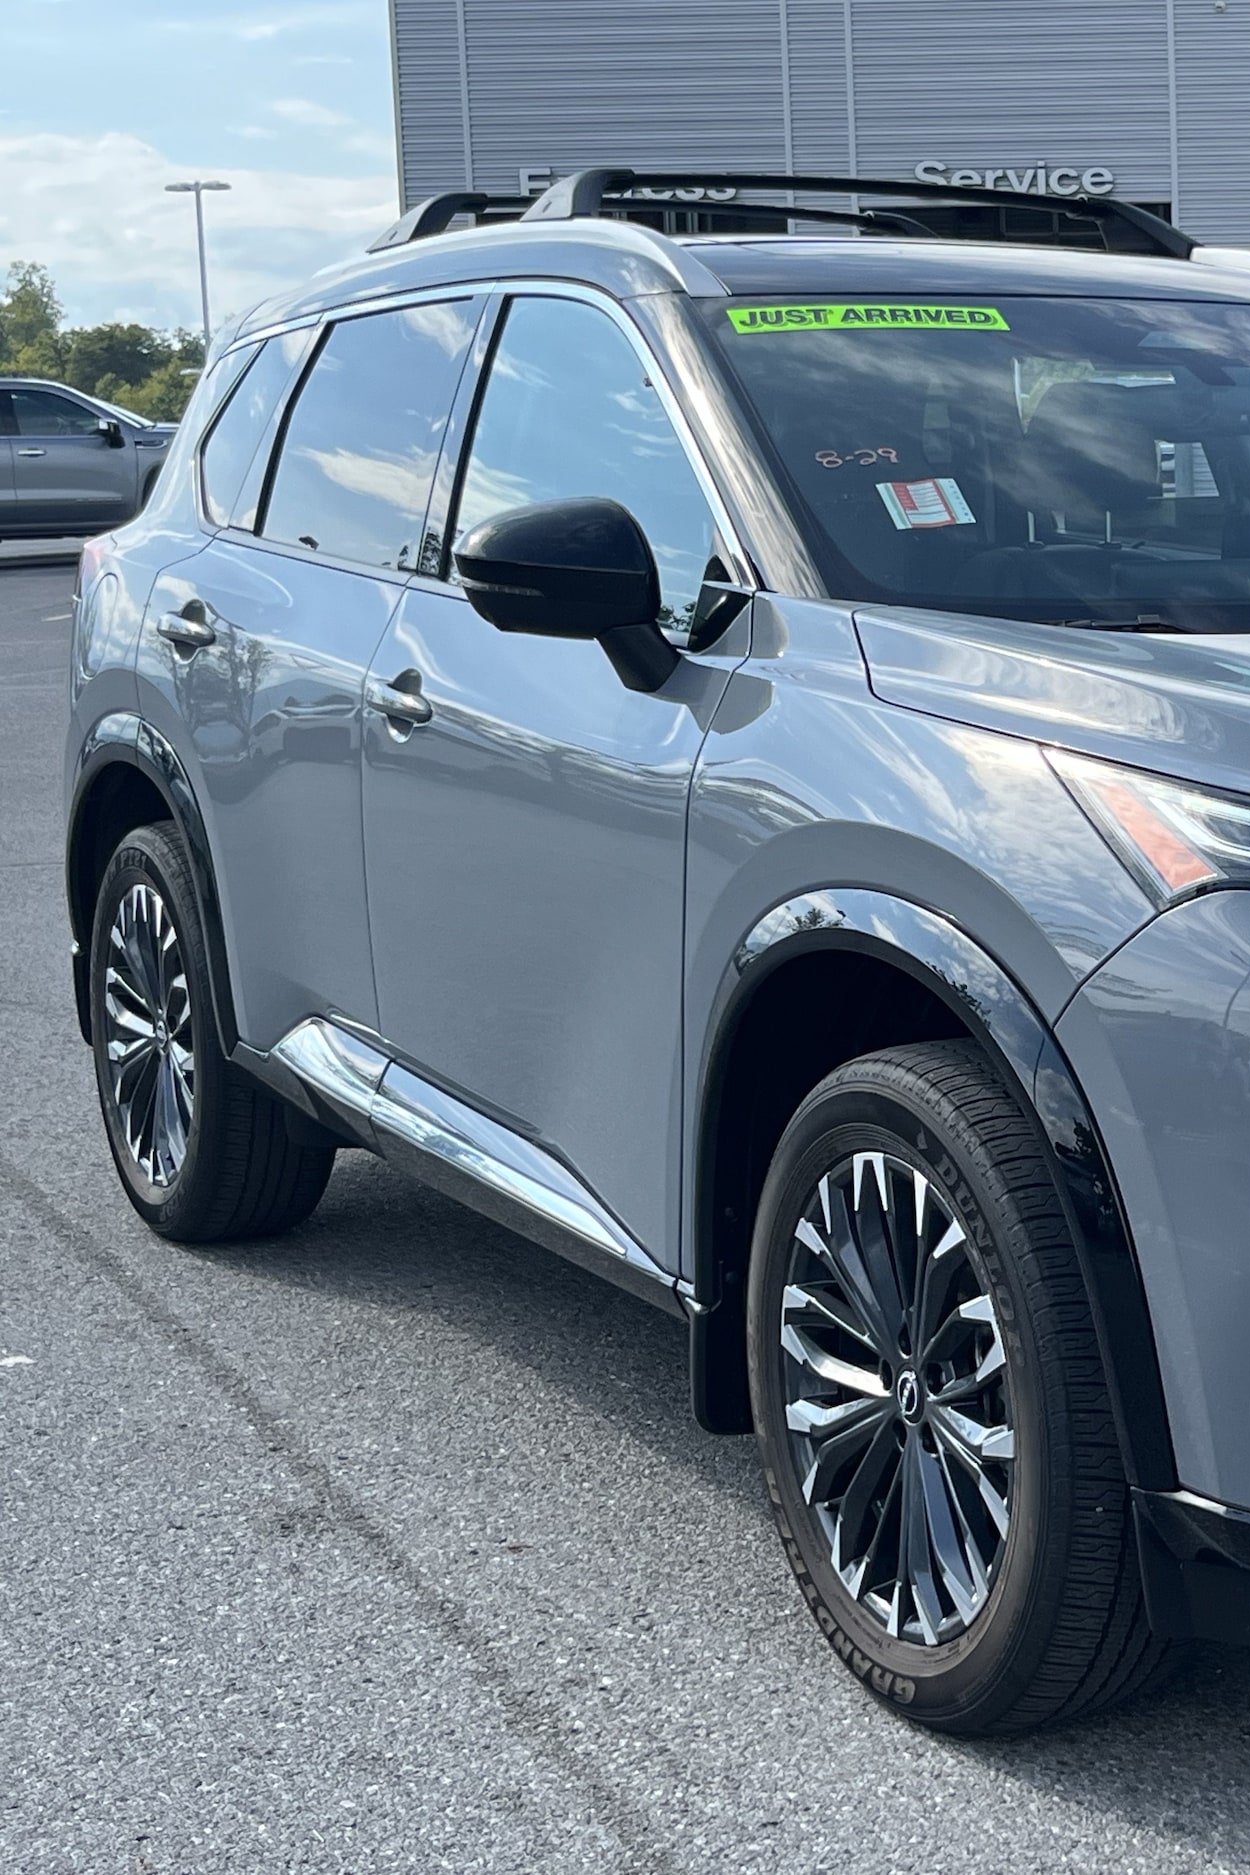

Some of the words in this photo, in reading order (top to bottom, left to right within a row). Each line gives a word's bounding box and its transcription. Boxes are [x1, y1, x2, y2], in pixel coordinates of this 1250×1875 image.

[914, 160, 1114, 195] Service
[739, 308, 832, 328] JUST
[841, 307, 997, 326] ARRIVED
[815, 448, 899, 468] 8-29
